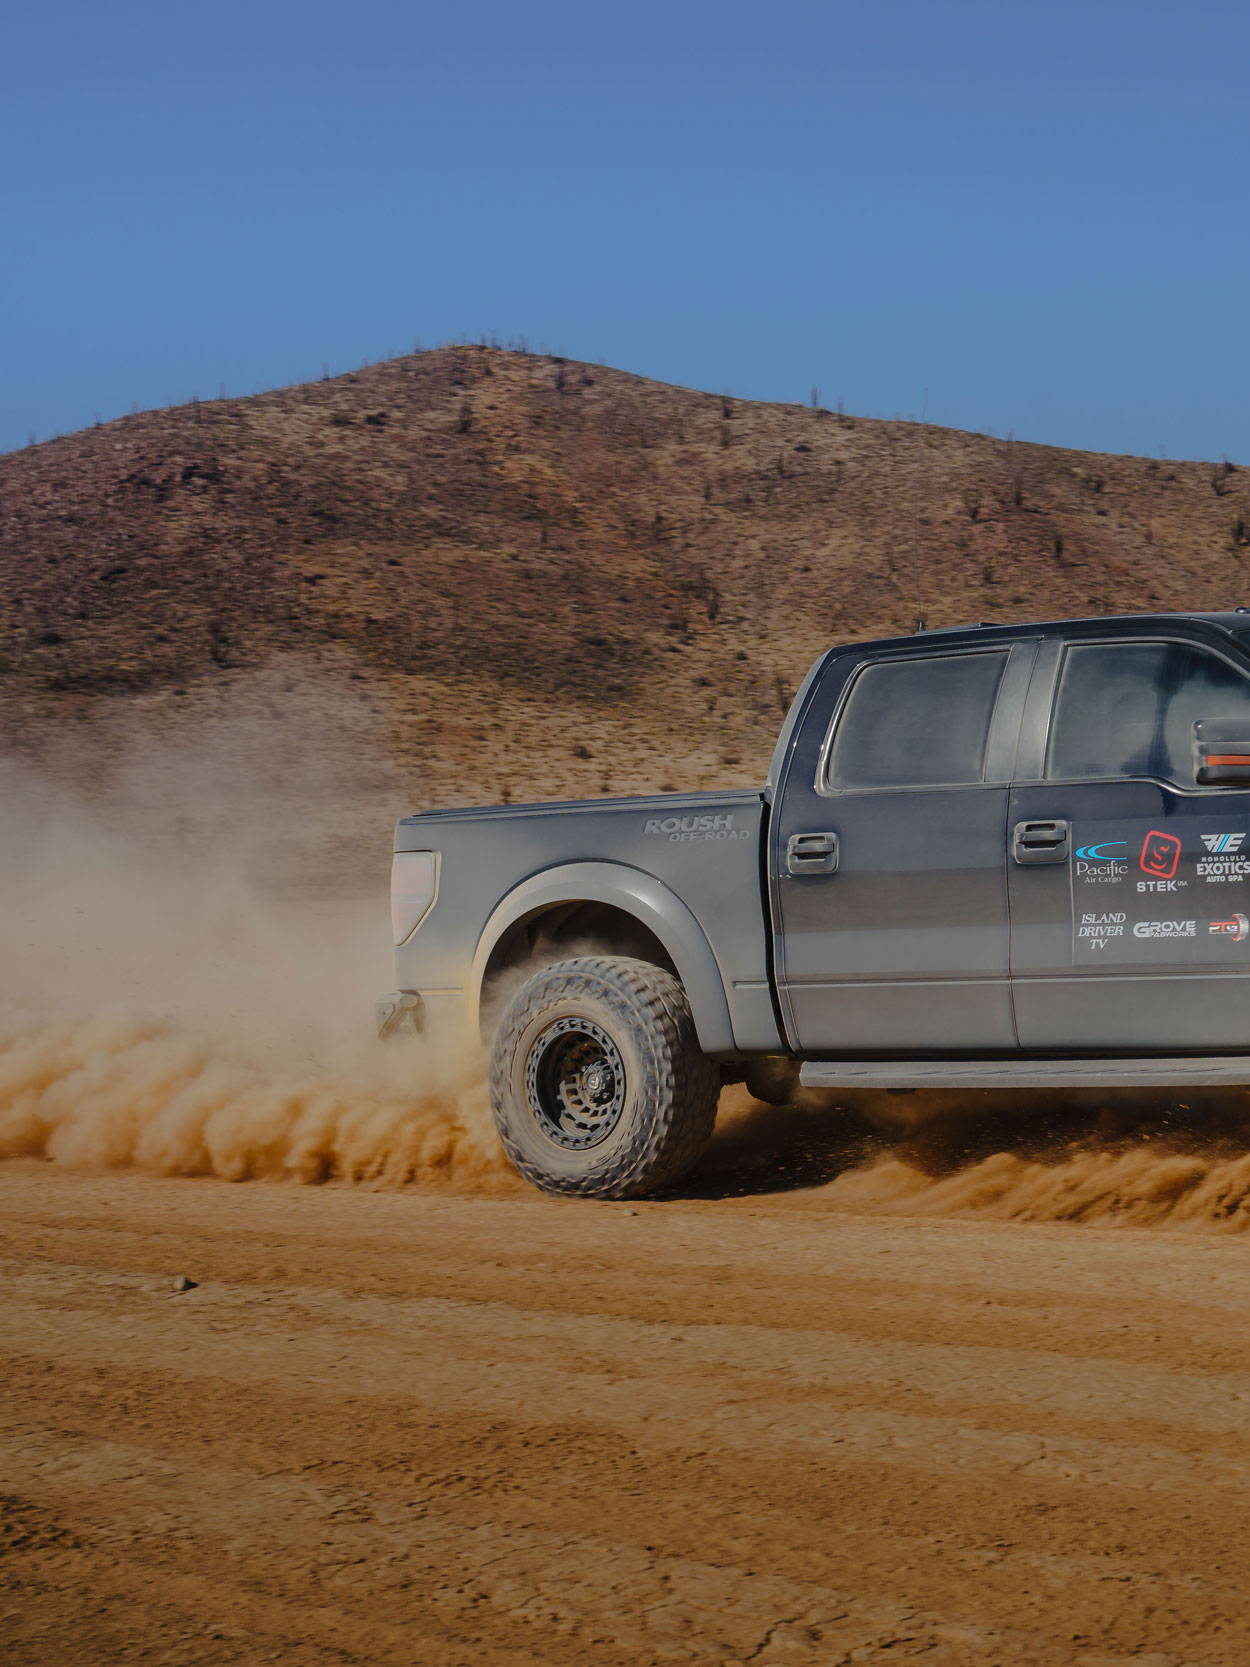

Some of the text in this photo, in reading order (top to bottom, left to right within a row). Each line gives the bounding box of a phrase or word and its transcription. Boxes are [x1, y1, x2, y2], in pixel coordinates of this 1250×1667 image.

[644, 814, 734, 834] ROUSH
[669, 830, 750, 842] OFF-ROAD
[1201, 855, 1246, 863] HONOLULU
[1076, 860, 1129, 877] Pacific
[1084, 875, 1122, 884] Air Cargo
[1206, 874, 1244, 883] AUTO SPA
[1137, 881, 1177, 892] STEK
[1081, 912, 1126, 924] ISLAND
[1078, 926, 1124, 937] DRIVER
[1133, 921, 1197, 938] GROVE
[1090, 938, 1108, 950] TV
